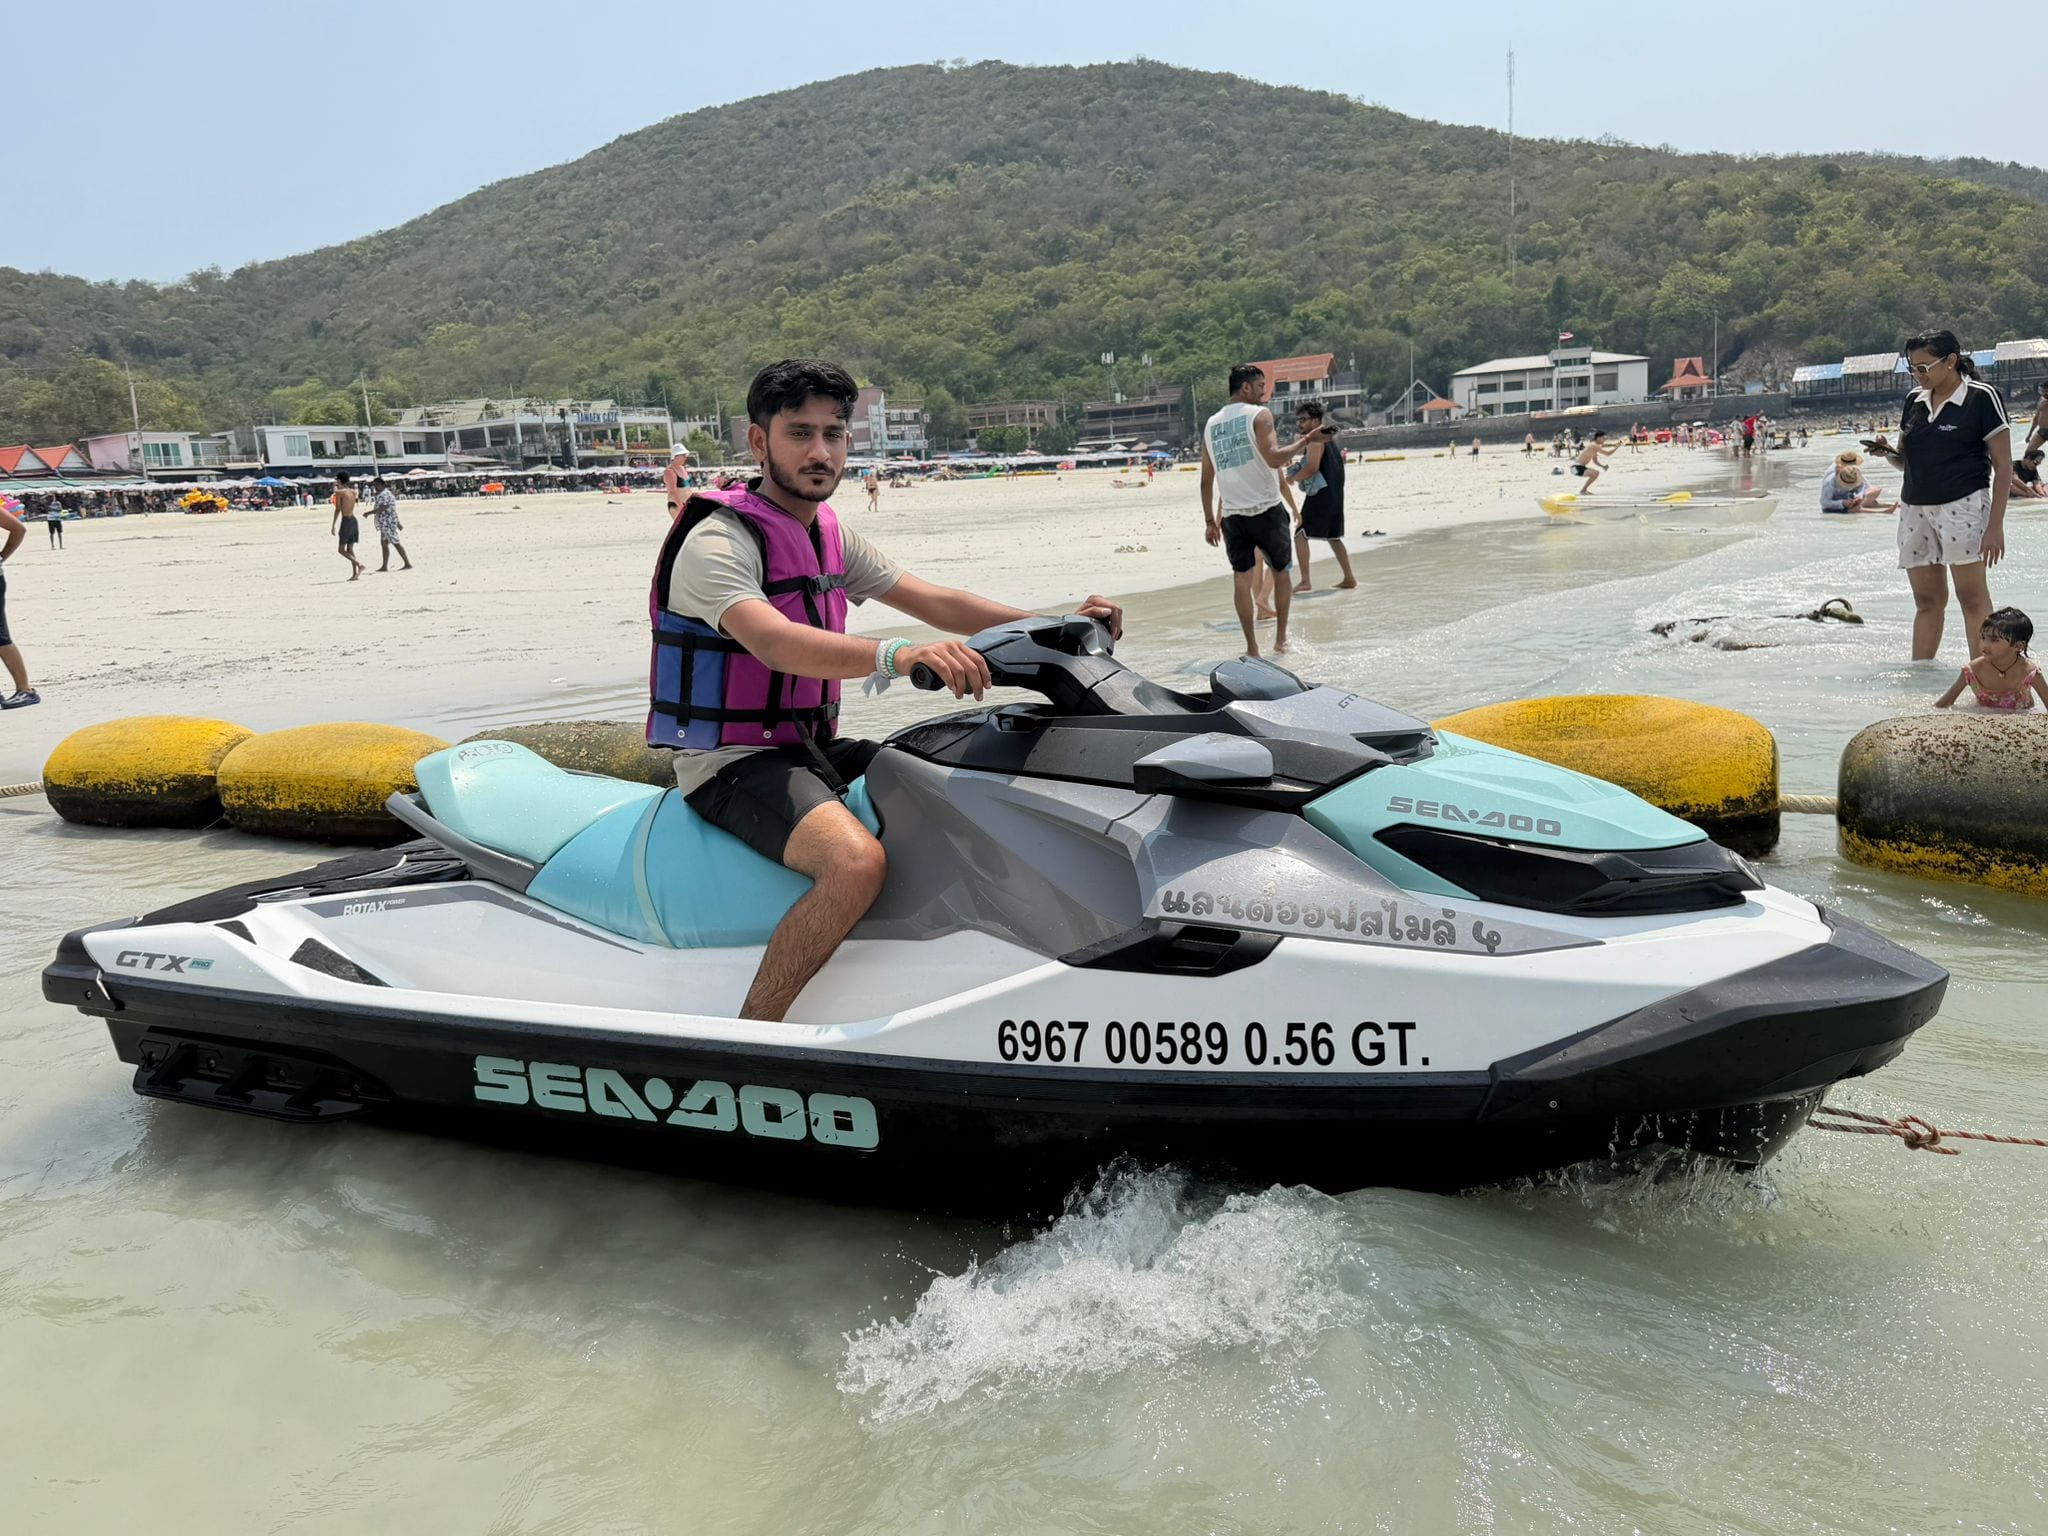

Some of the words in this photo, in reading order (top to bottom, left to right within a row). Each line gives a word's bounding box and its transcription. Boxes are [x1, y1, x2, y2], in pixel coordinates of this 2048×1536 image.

[1337, 693, 1358, 709] GT
[343, 901, 387, 917] ROTAX
[116, 950, 191, 974] GTX
[190, 959, 213, 969] PRO
[998, 1019, 1089, 1063] 6967
[1105, 1021, 1229, 1065] 00589
[1244, 1021, 1335, 1066] 0.56
[1352, 1021, 1430, 1066] GT.
